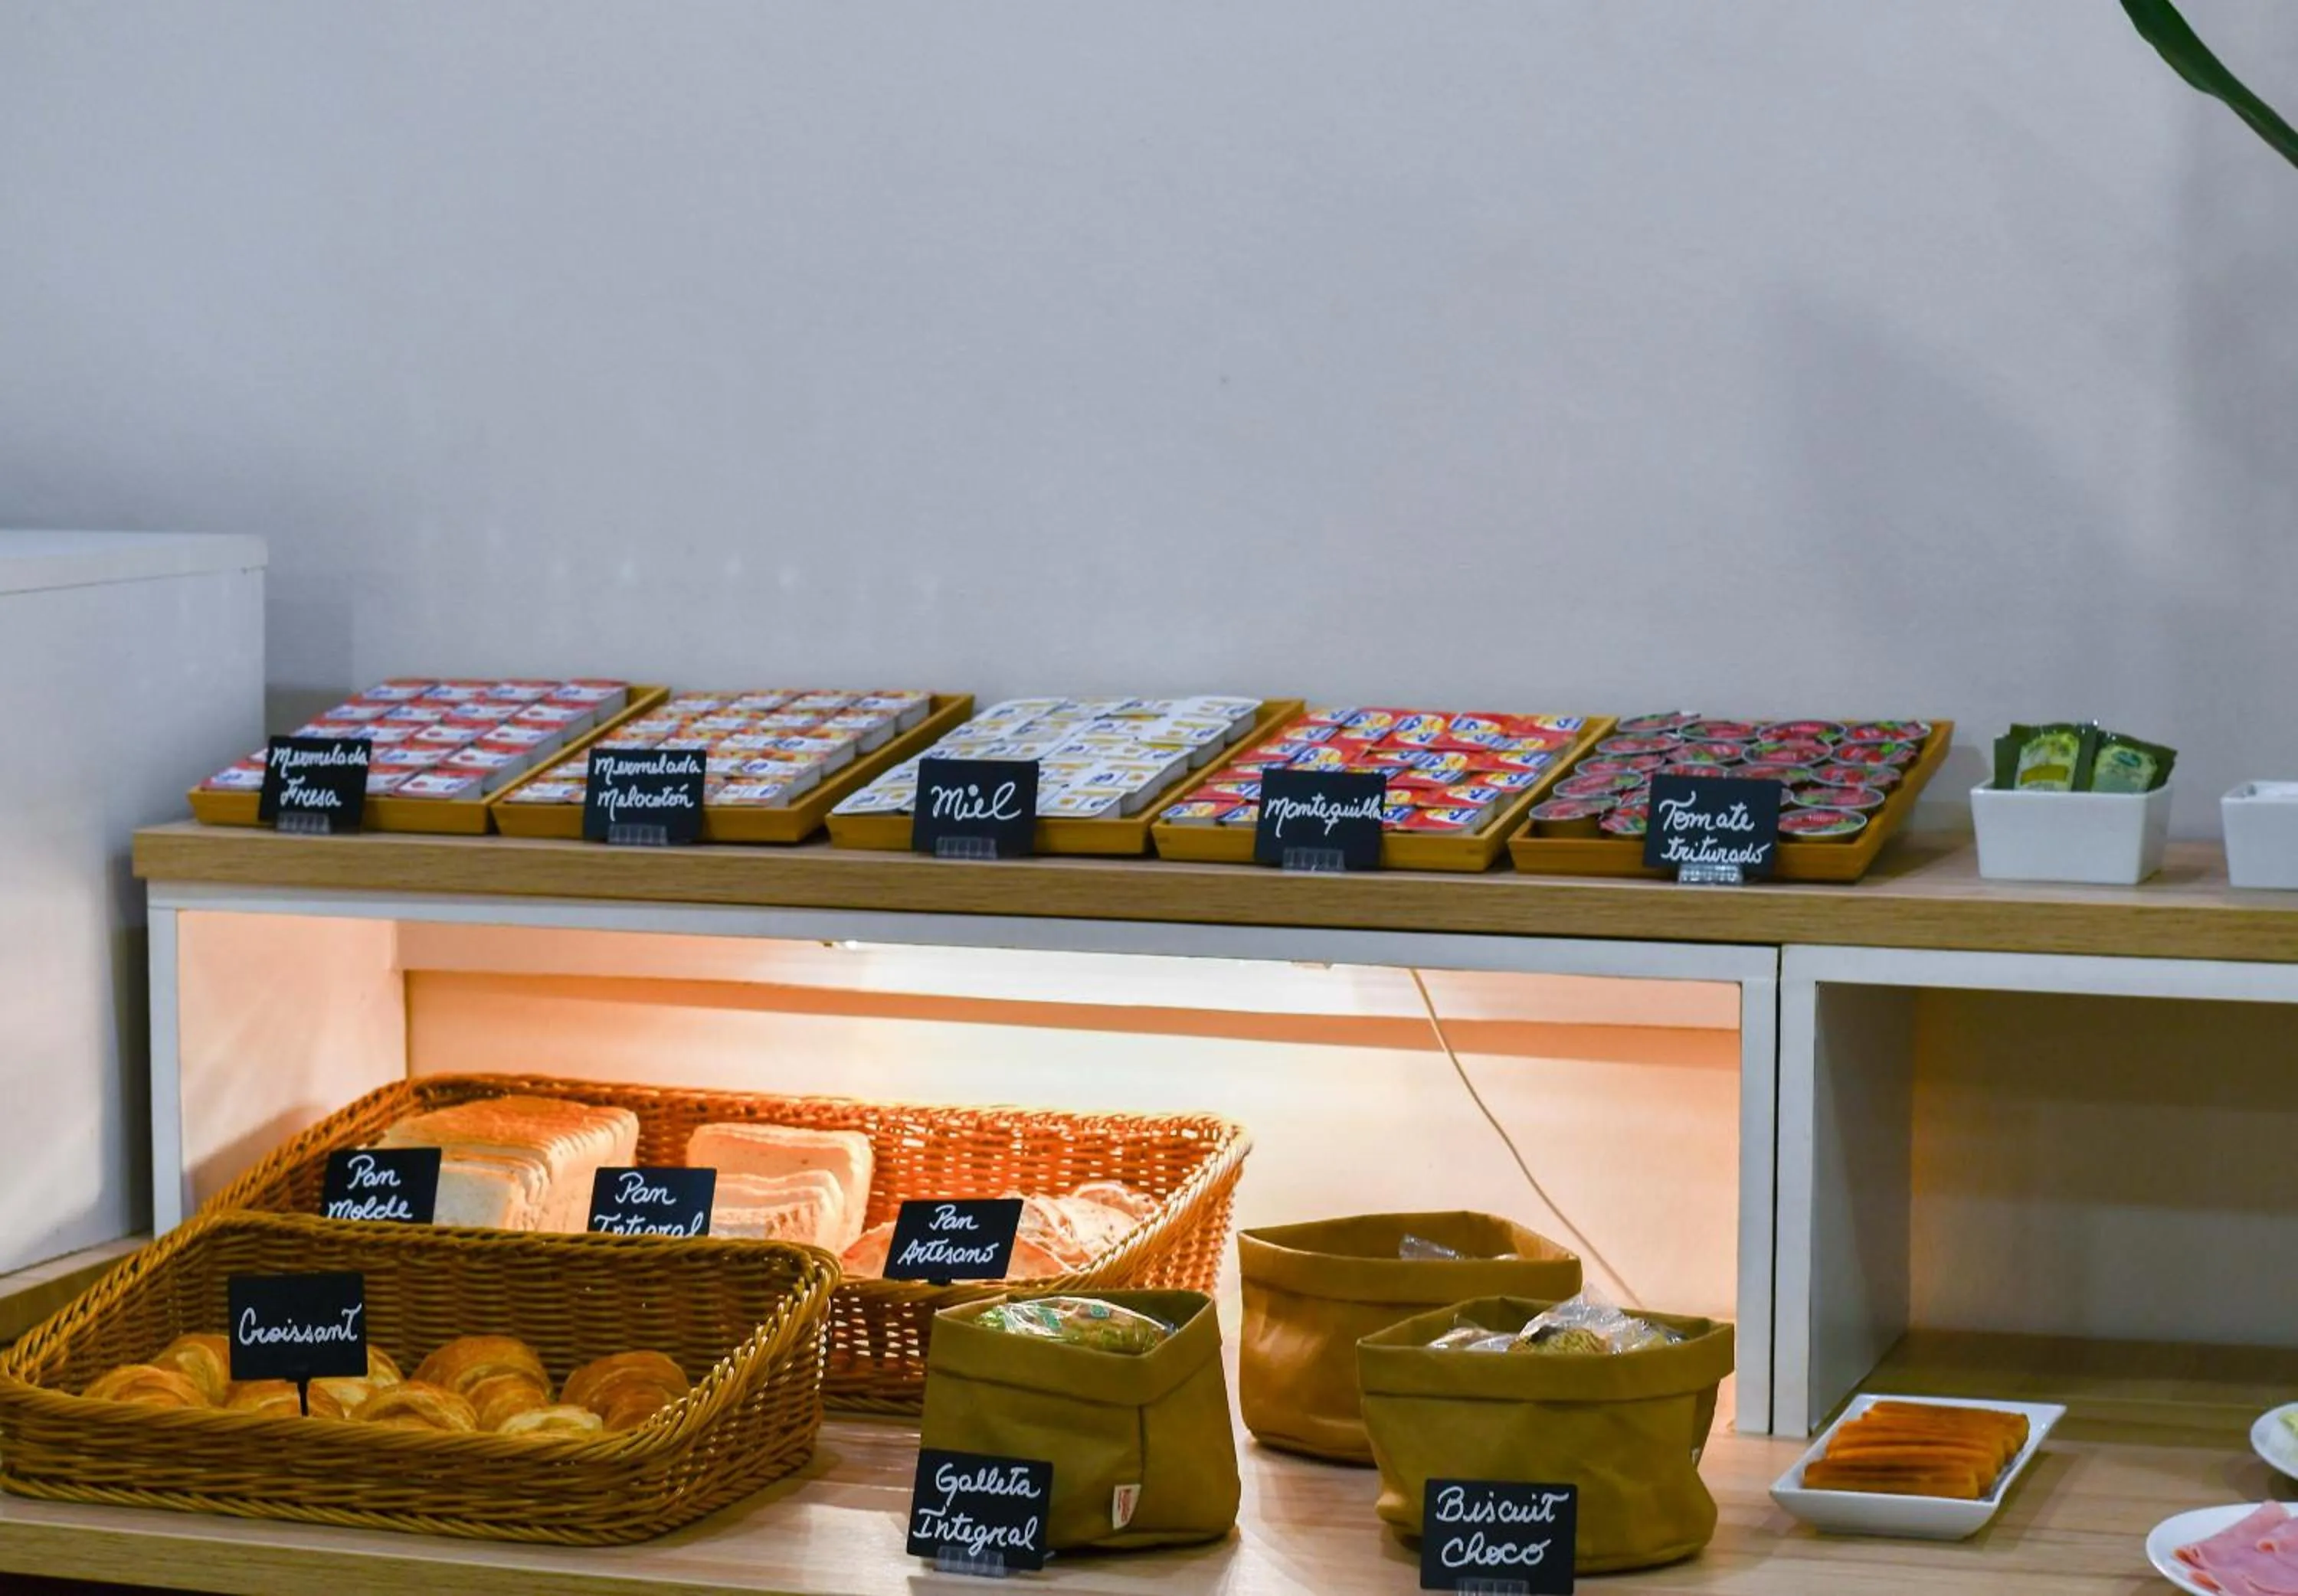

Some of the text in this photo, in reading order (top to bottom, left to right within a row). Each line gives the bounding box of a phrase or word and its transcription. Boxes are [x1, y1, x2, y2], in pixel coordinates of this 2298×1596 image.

[270, 743, 368, 779] Mermelada
[594, 753, 702, 786] Mermelada
[280, 774, 342, 807] Fresa
[597, 783, 695, 822] Melocotón
[931, 781, 1023, 822] Miel
[1658, 790, 1756, 832] Tomate
[1660, 835, 1772, 865] triturado
[347, 1154, 401, 1189] Pan
[615, 1171, 677, 1205] Pan
[327, 1195, 414, 1220] Molde
[929, 1204, 980, 1231] Pan
[897, 1238, 1000, 1266] Artesano
[238, 1302, 362, 1346] Croissant
[935, 1463, 1041, 1507] Galleta
[1435, 1486, 1570, 1523] Biscuit
[912, 1504, 1038, 1557] Integral
[1442, 1532, 1552, 1568] Choco
